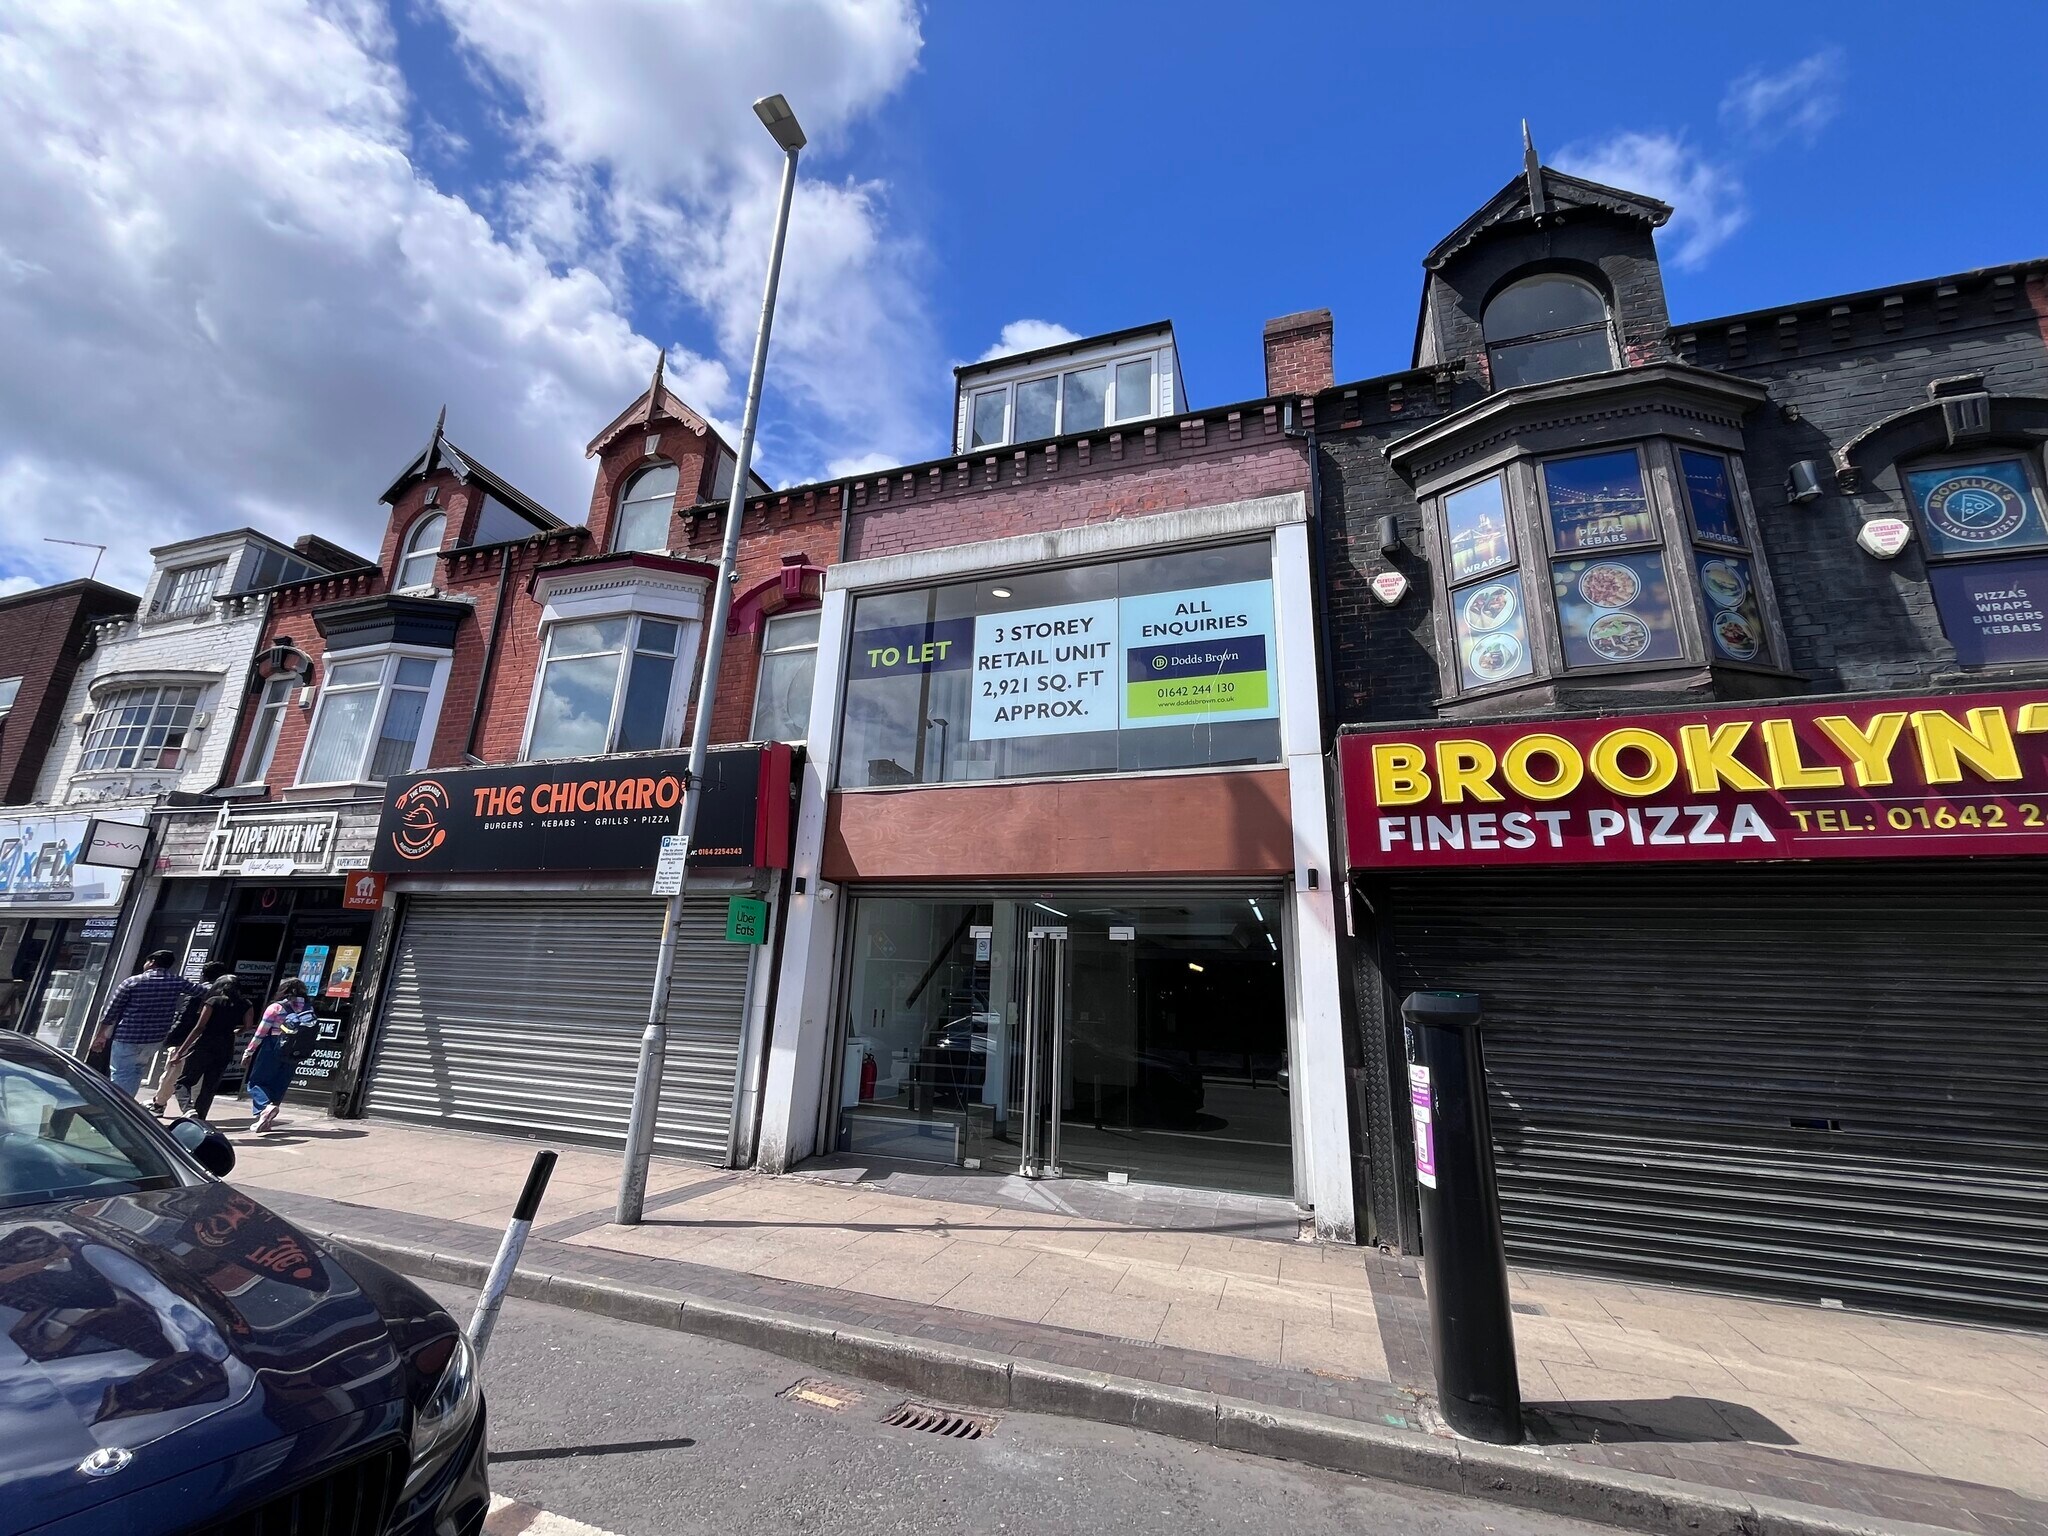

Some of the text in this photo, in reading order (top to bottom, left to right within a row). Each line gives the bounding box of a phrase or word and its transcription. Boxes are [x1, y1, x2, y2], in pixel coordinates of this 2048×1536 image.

[1930, 479, 2015, 508] BROOKLYN'S
[1579, 524, 1624, 536] PIZZAS
[1940, 514, 2020, 538] FINEST PIZZA
[1578, 534, 1628, 546] KEBABS
[1697, 530, 1739, 544] BURGERS
[1462, 556, 1502, 574] WRAPS
[1974, 589, 2028, 601] PIZZAS
[1174, 600, 1212, 616] ALL
[1976, 601, 2032, 612] WRAPS
[1142, 614, 1248, 637] ENQUIRIES
[1972, 611, 2044, 624] BURGERS
[994, 617, 1094, 643] 3 STOREY
[1982, 623, 2043, 636] KEBABS
[867, 640, 952, 668] TO LET
[978, 642, 1111, 671] RETAIL UNIT
[1171, 654, 1202, 666] Dodds
[1205, 651, 1239, 663] Brown
[983, 670, 1104, 699] 2,921 SQ. FT
[1158, 682, 1235, 698] 01642 244 130
[1158, 696, 1234, 708] www.doddsbrown.co.uk
[994, 700, 1088, 722] APPROX.
[473, 785, 526, 816] THE
[484, 815, 670, 830] BURGERS KEBABS GRILLS PIZZA
[1790, 803, 2048, 832] TEL: 01642 2
[1378, 802, 1777, 852] FINEST PIZZA
[92, 839, 142, 852] OXVA
[231, 824, 327, 854] VAPE WITH ME
[737, 910, 756, 923] Uber
[736, 924, 755, 936] Eats
[325, 1023, 336, 1033] ME
